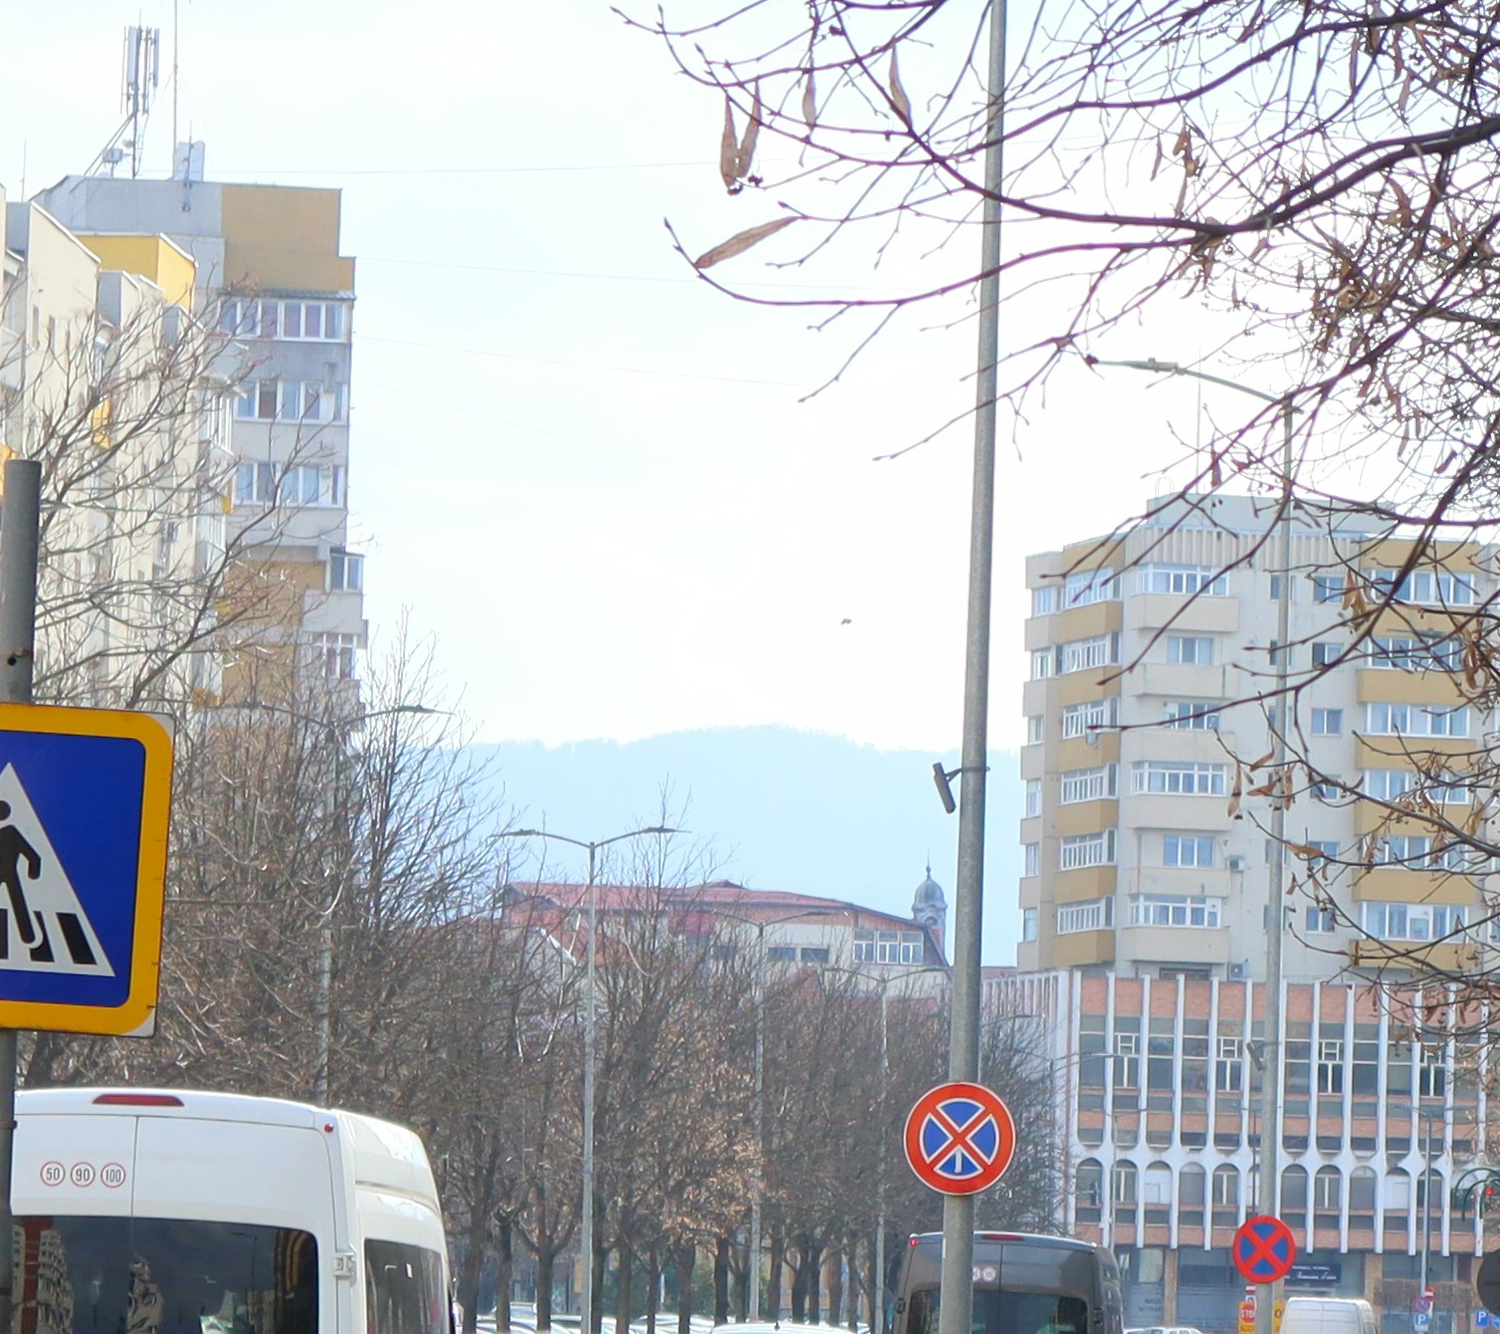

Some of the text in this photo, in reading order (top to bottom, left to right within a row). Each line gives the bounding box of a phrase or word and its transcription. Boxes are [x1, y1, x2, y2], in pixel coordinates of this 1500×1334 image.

[46, 1167, 61, 1181] 50
[75, 1168, 91, 1182] 90
[105, 1169, 121, 1183] 100
[1478, 1311, 1487, 1323] P
